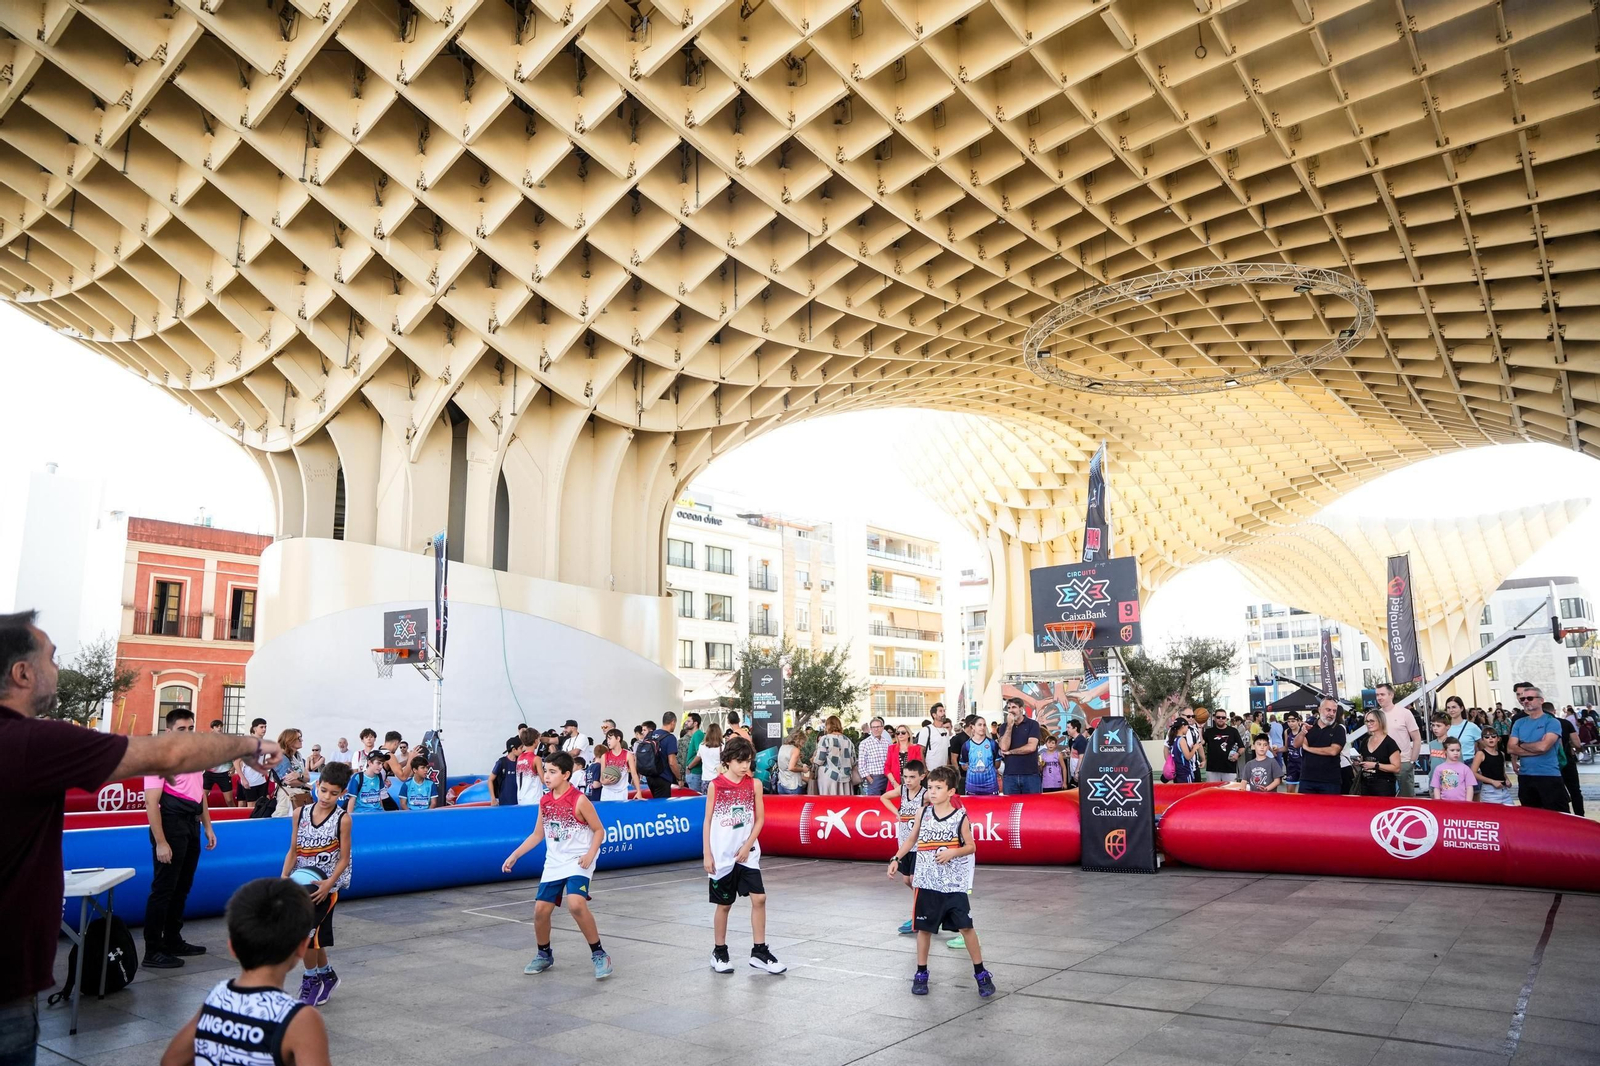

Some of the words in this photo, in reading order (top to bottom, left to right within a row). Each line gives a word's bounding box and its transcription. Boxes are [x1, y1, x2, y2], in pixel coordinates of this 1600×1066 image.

[676, 510, 702, 522] ocean
[703, 513, 723, 526] drive
[1067, 569, 1096, 578] CIRCUITO
[1061, 609, 1107, 622] CaixaBank
[1124, 603, 1133, 616] 9
[1092, 806, 1138, 817] CaixaBank
[1443, 819, 1499, 830] UNIVERSO
[1443, 828, 1500, 842] MUJER
[601, 843, 633, 855] SPAÑA
